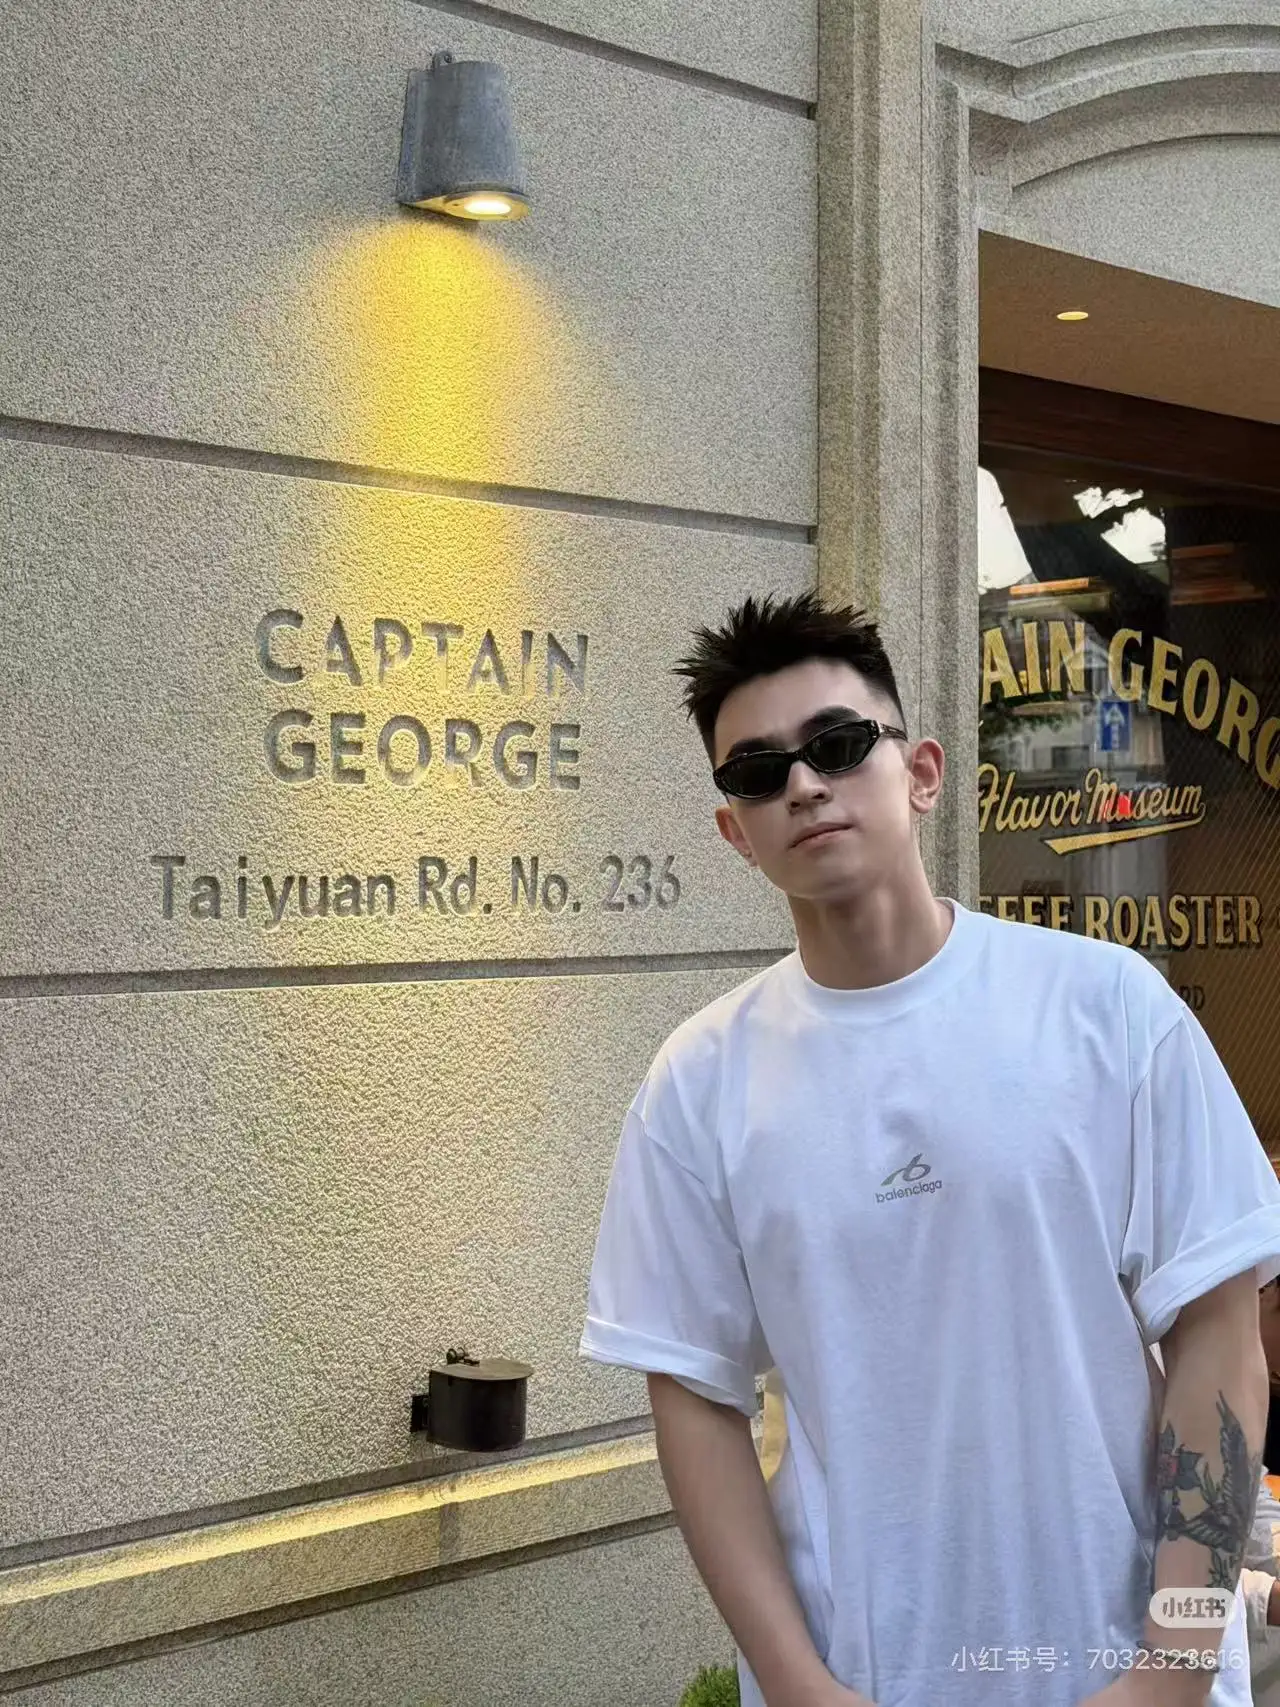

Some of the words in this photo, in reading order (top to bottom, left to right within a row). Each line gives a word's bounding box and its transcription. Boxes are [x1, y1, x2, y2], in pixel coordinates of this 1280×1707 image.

[255, 608, 589, 698] CAPTAIN
[263, 708, 584, 791] GEORGE
[978, 763, 1082, 833] Flavor
[1085, 767, 1206, 825] Museum
[150, 854, 396, 931] Taiyuan
[418, 855, 493, 917] Rd.
[510, 855, 582, 915] No.
[600, 855, 681, 912] 236
[1085, 894, 1262, 947] ROASTER
[875, 1180, 942, 1204] balenciaga
